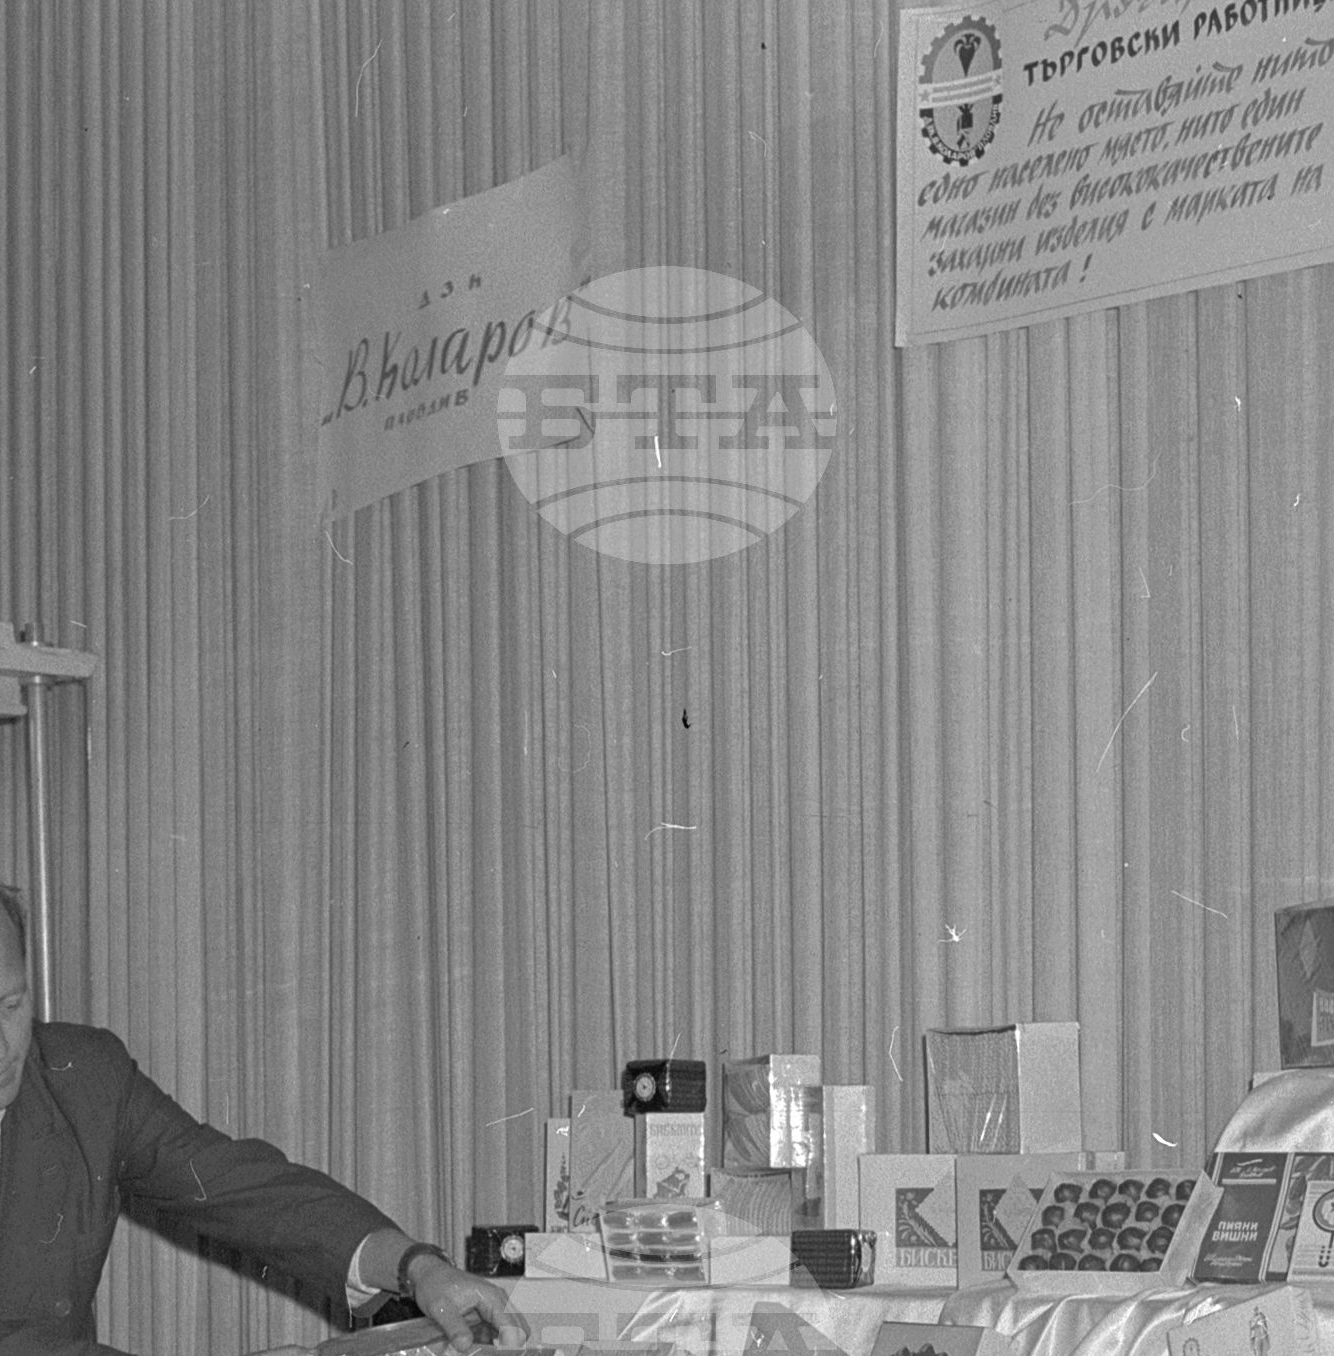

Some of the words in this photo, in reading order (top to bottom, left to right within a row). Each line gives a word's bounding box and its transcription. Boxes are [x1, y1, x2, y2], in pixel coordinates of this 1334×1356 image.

[1023, 20, 1180, 86] ТЪРГОВСКИ
[917, 171, 990, 207] едно
[987, 142, 1099, 194] населено
[1175, 103, 1241, 146] нито
[1242, 87, 1306, 131] един
[1027, 100, 1065, 147] Не
[920, 199, 1022, 242] магазин
[1026, 183, 1062, 220] без
[1069, 122, 1323, 210] висококачествените
[928, 236, 1027, 277] захарни
[1035, 209, 1130, 255] изделия
[1141, 201, 1157, 231] с
[1163, 173, 1279, 225] марката
[1291, 164, 1324, 196] на
[931, 260, 1072, 312] комбината
[1212, 1231, 1257, 1242] ВИШНИ
[1218, 1221, 1258, 1231] ПИЯНИ
